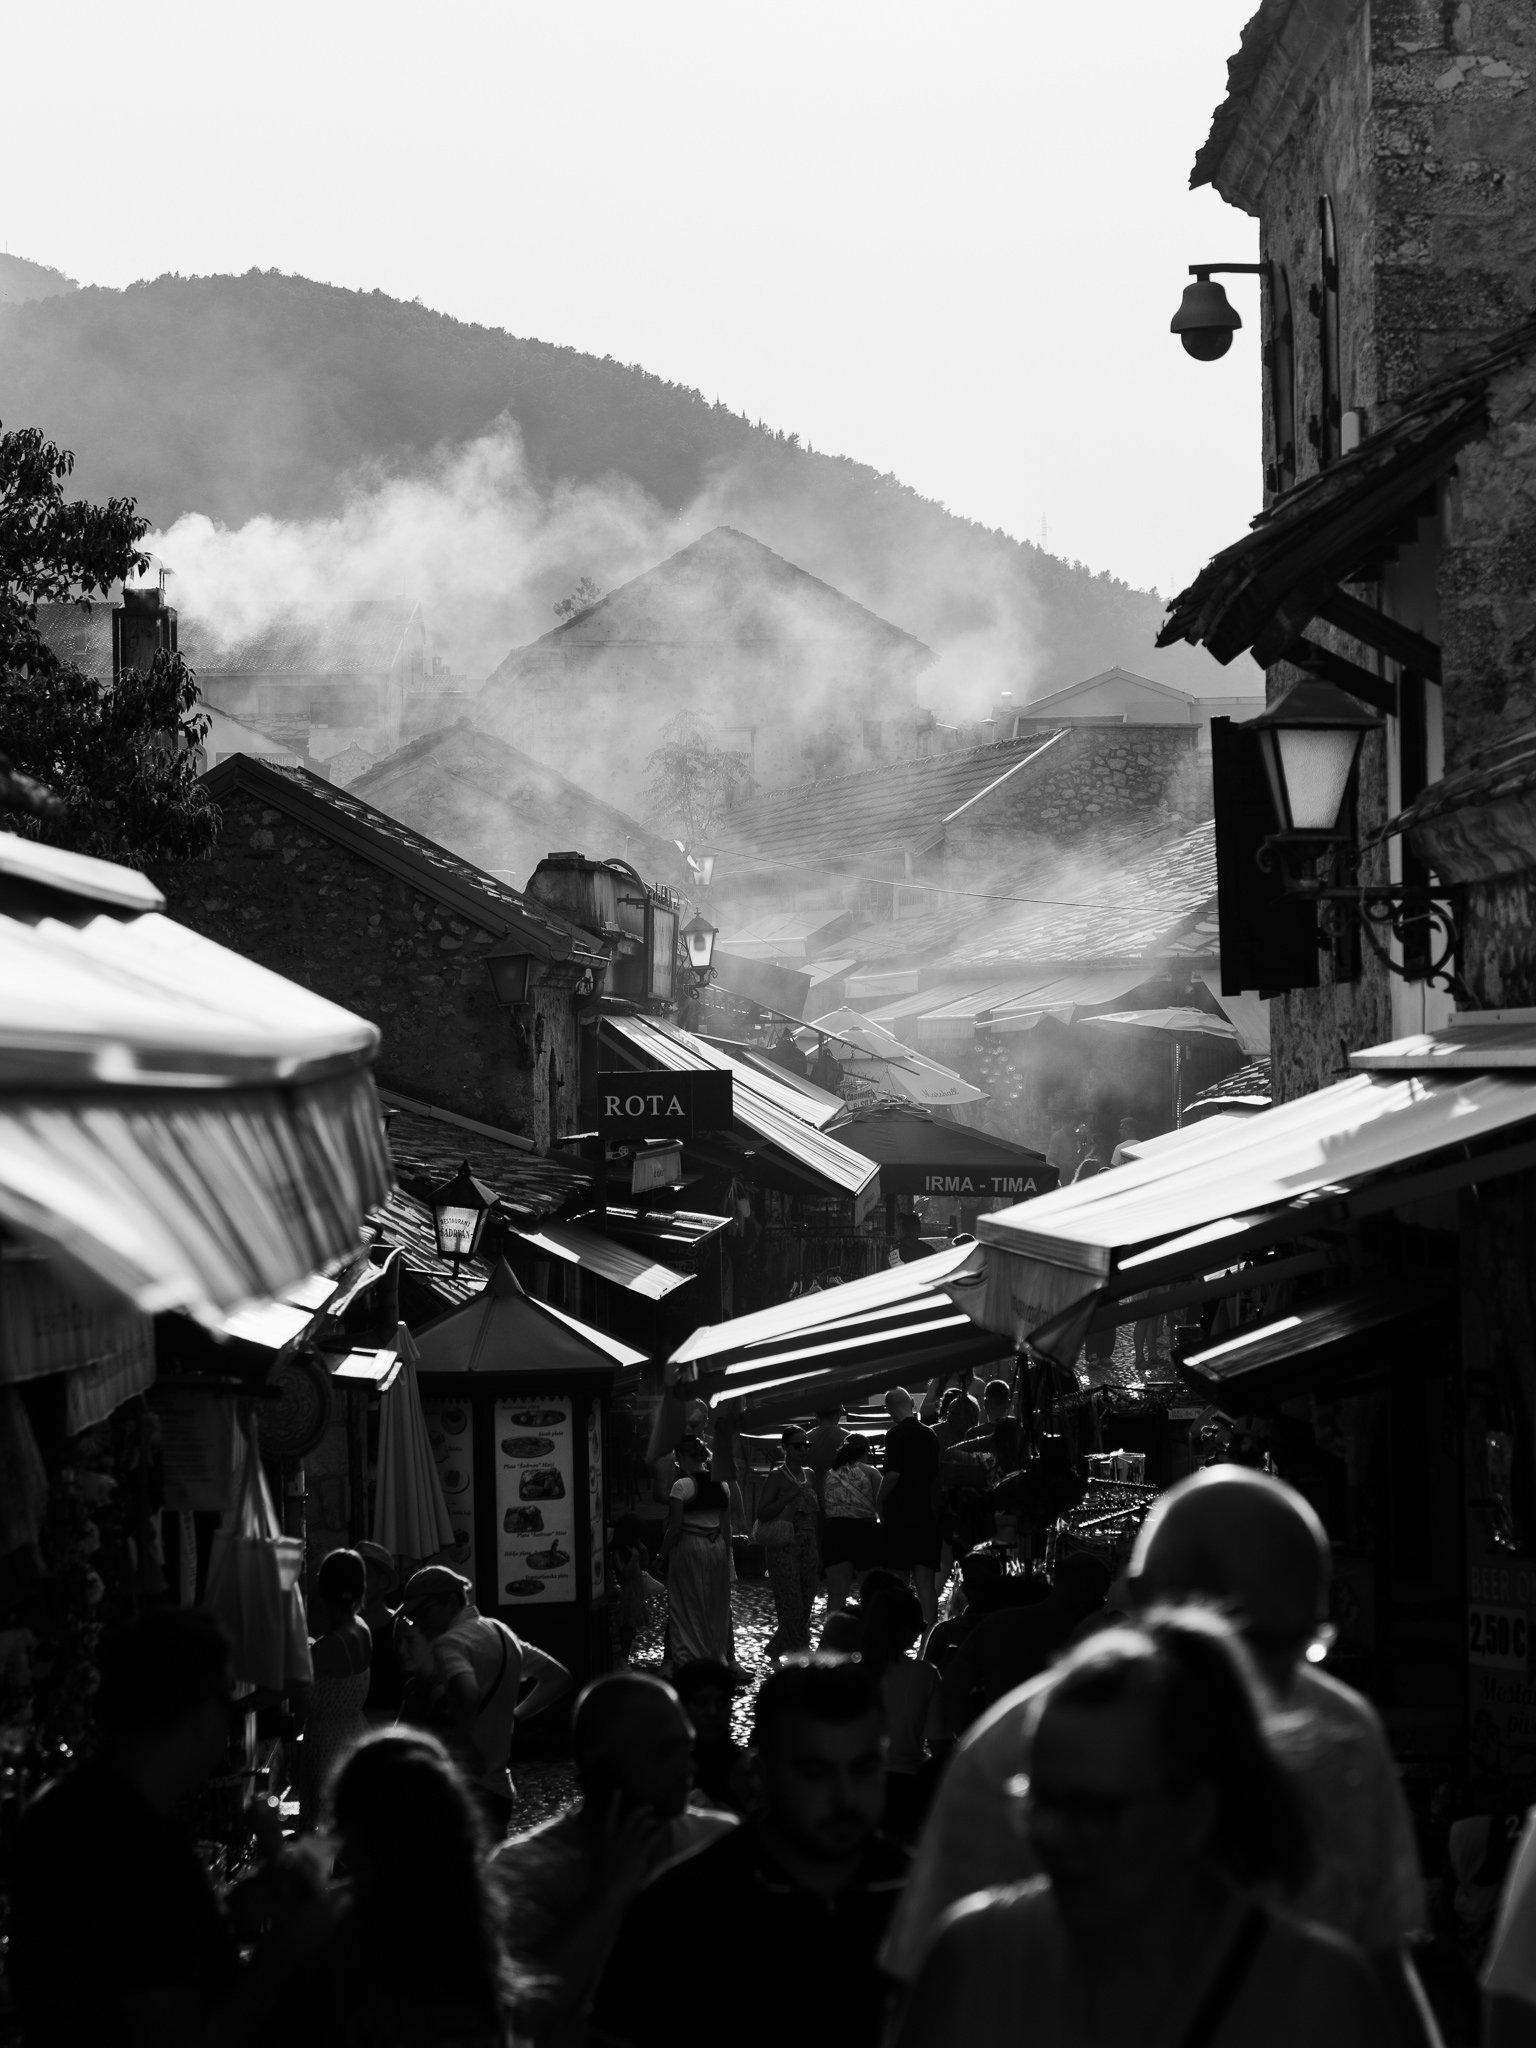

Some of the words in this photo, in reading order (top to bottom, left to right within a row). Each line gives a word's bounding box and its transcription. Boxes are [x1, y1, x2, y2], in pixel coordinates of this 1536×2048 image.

[604, 1095, 685, 1116] ROTA
[925, 1176, 974, 1192] IRMA
[990, 1177, 1037, 1193] TIMA
[440, 1217, 471, 1228] RESTAURANT
[1471, 1566, 1510, 1600] BEER
[1470, 1613, 1509, 1657] 2,50
[1479, 1676, 1536, 1706] Mosta
